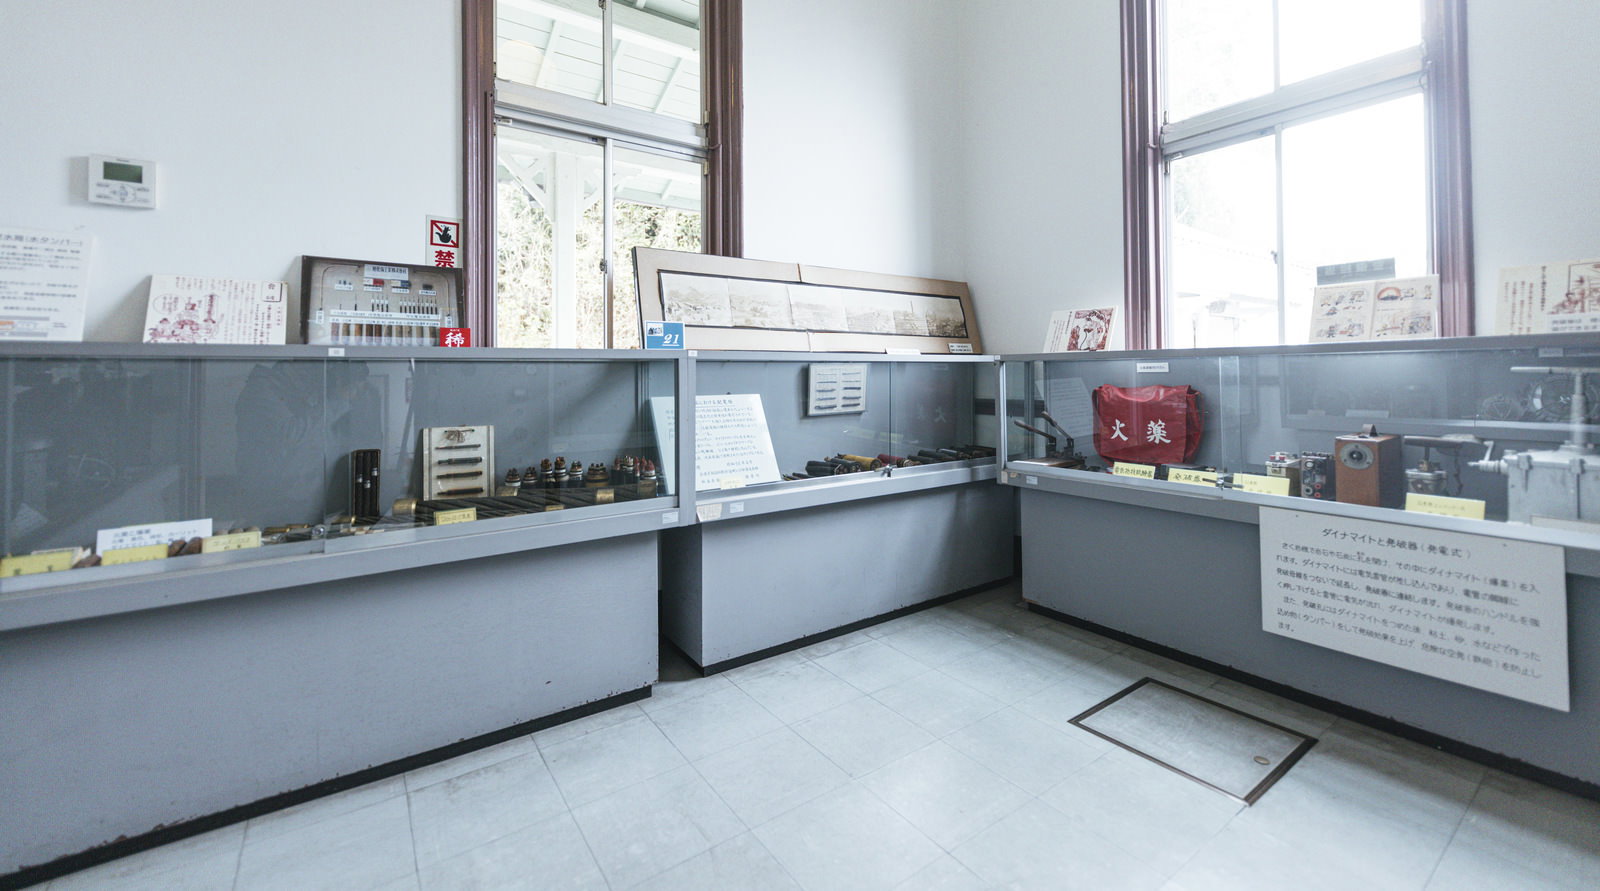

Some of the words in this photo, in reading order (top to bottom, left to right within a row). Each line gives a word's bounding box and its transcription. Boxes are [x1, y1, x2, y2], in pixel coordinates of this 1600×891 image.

[435, 250, 454, 268] 禁
[664, 333, 679, 344] 21
[1110, 418, 1171, 444] 火薬
